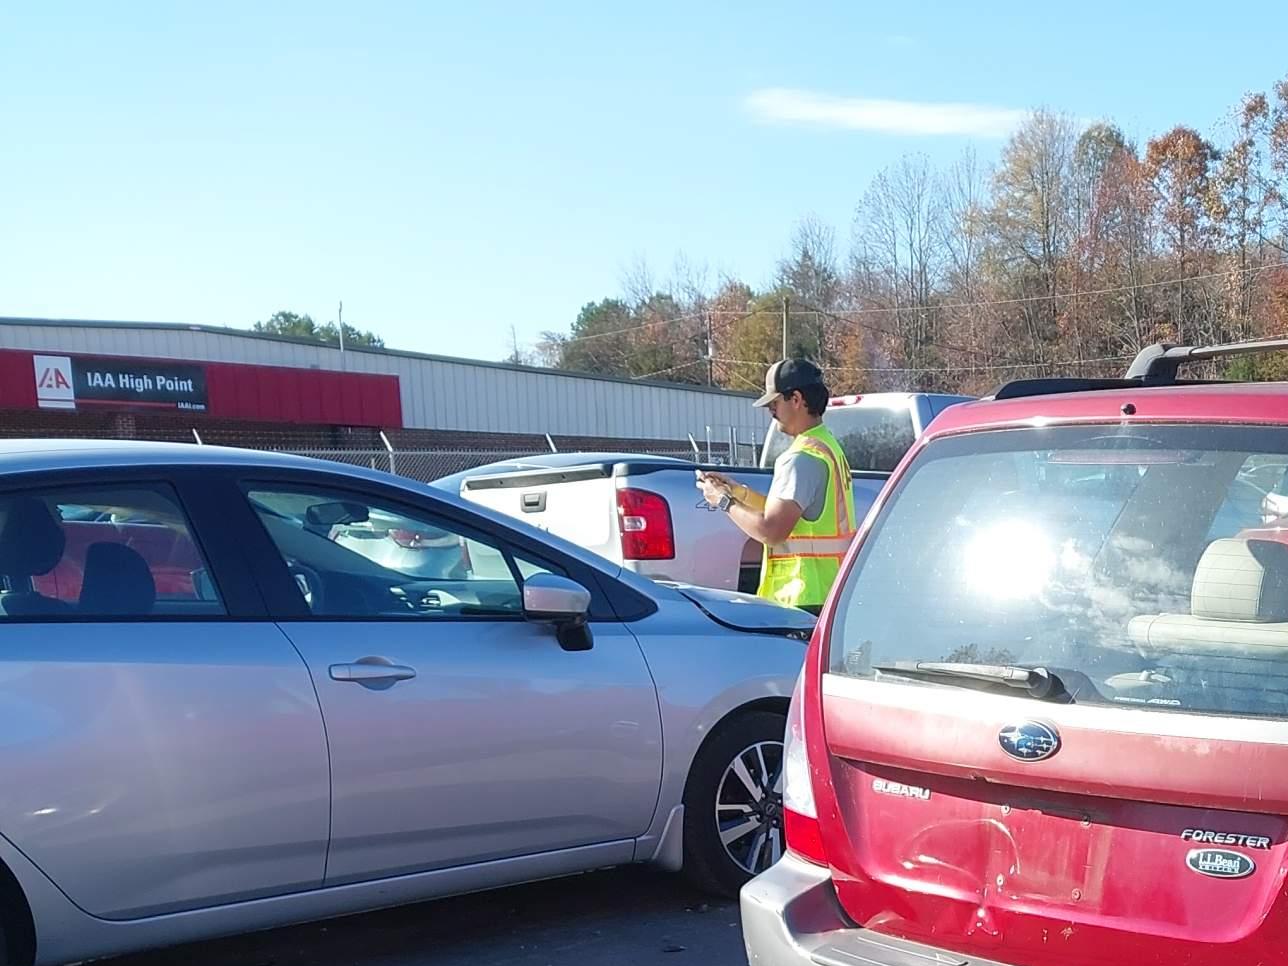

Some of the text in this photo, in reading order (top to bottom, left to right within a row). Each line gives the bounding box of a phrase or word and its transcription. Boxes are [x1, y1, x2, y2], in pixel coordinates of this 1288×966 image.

[86, 371, 194, 393] IAA High Point
[872, 778, 930, 800] SUBARU
[1180, 828, 1271, 849] FORESTER
